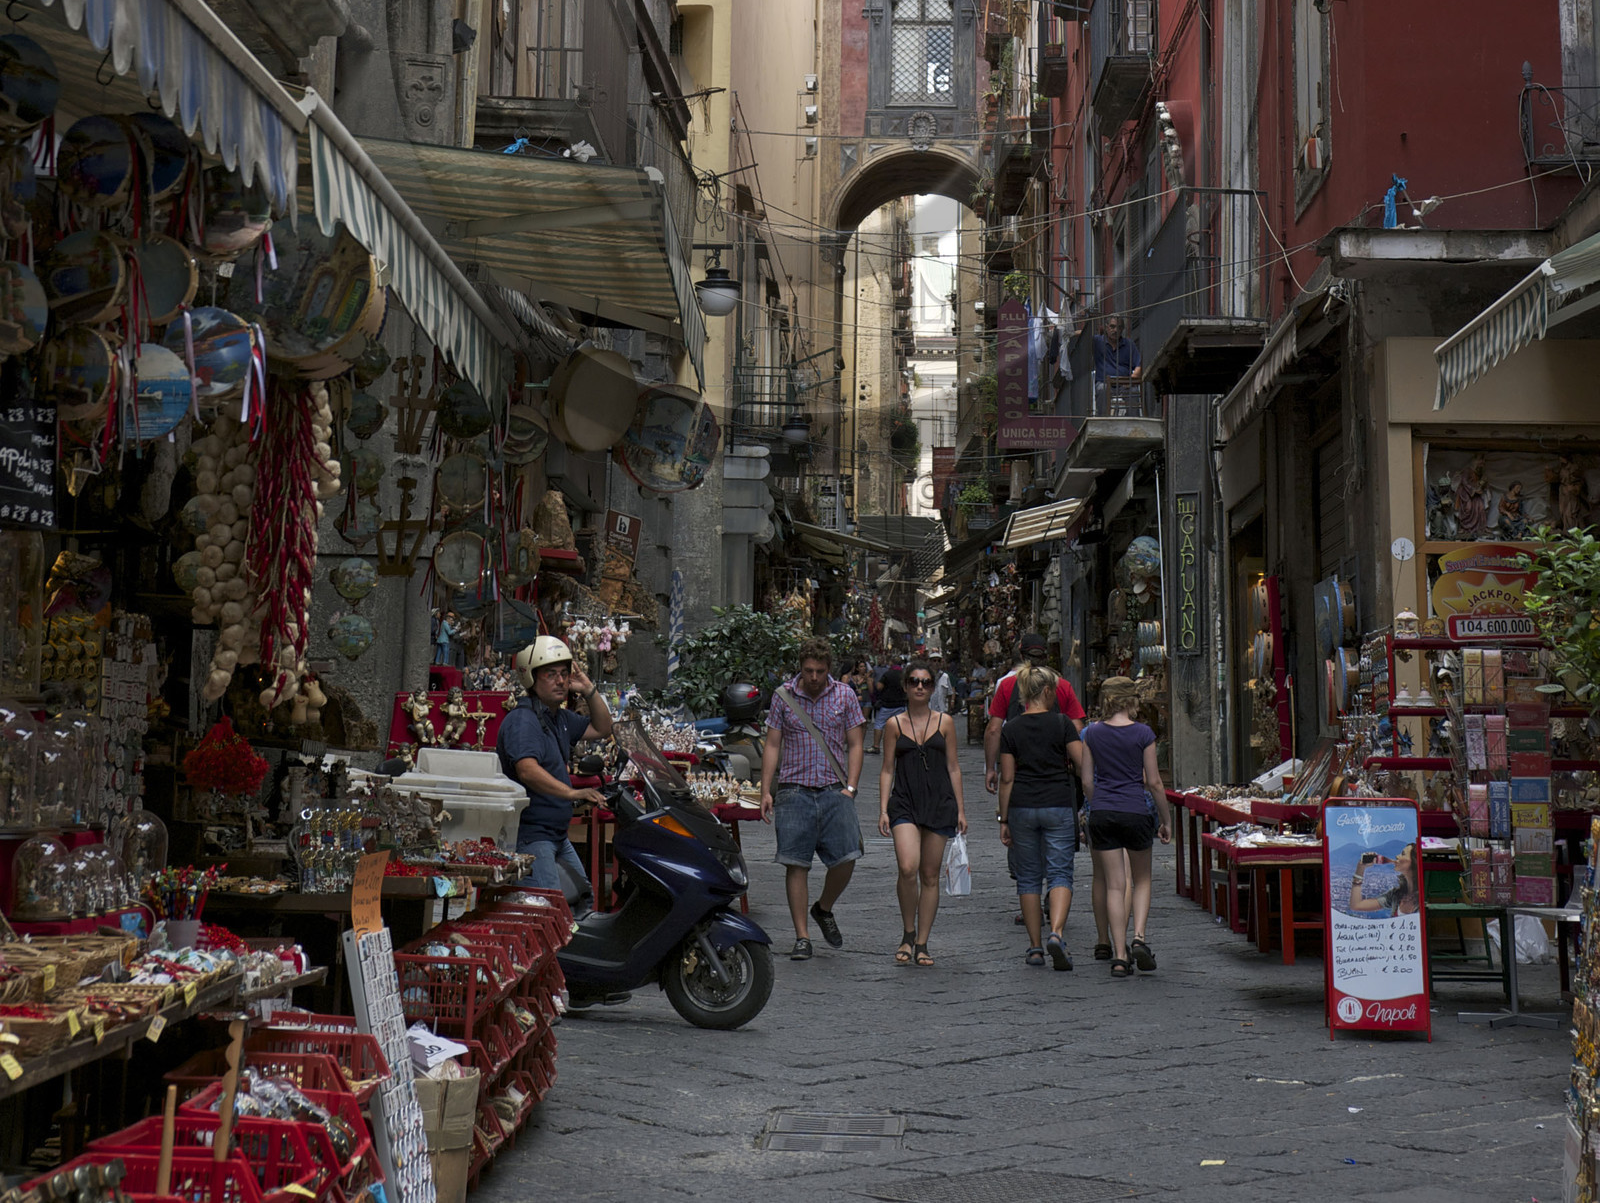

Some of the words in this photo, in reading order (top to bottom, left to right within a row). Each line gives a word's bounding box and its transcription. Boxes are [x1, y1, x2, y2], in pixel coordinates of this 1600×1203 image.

[1000, 313, 1026, 321] F.LLI
[1004, 325, 1023, 419] CAPUANO
[1002, 428, 1036, 438] UNICA
[1038, 428, 1067, 438] SEDE
[1179, 513, 1196, 649] CAPUANO
[1467, 589, 1519, 608] JACKPOT
[1460, 619, 1532, 634] 104.600.000
[1365, 1001, 1418, 1027] Napoli
